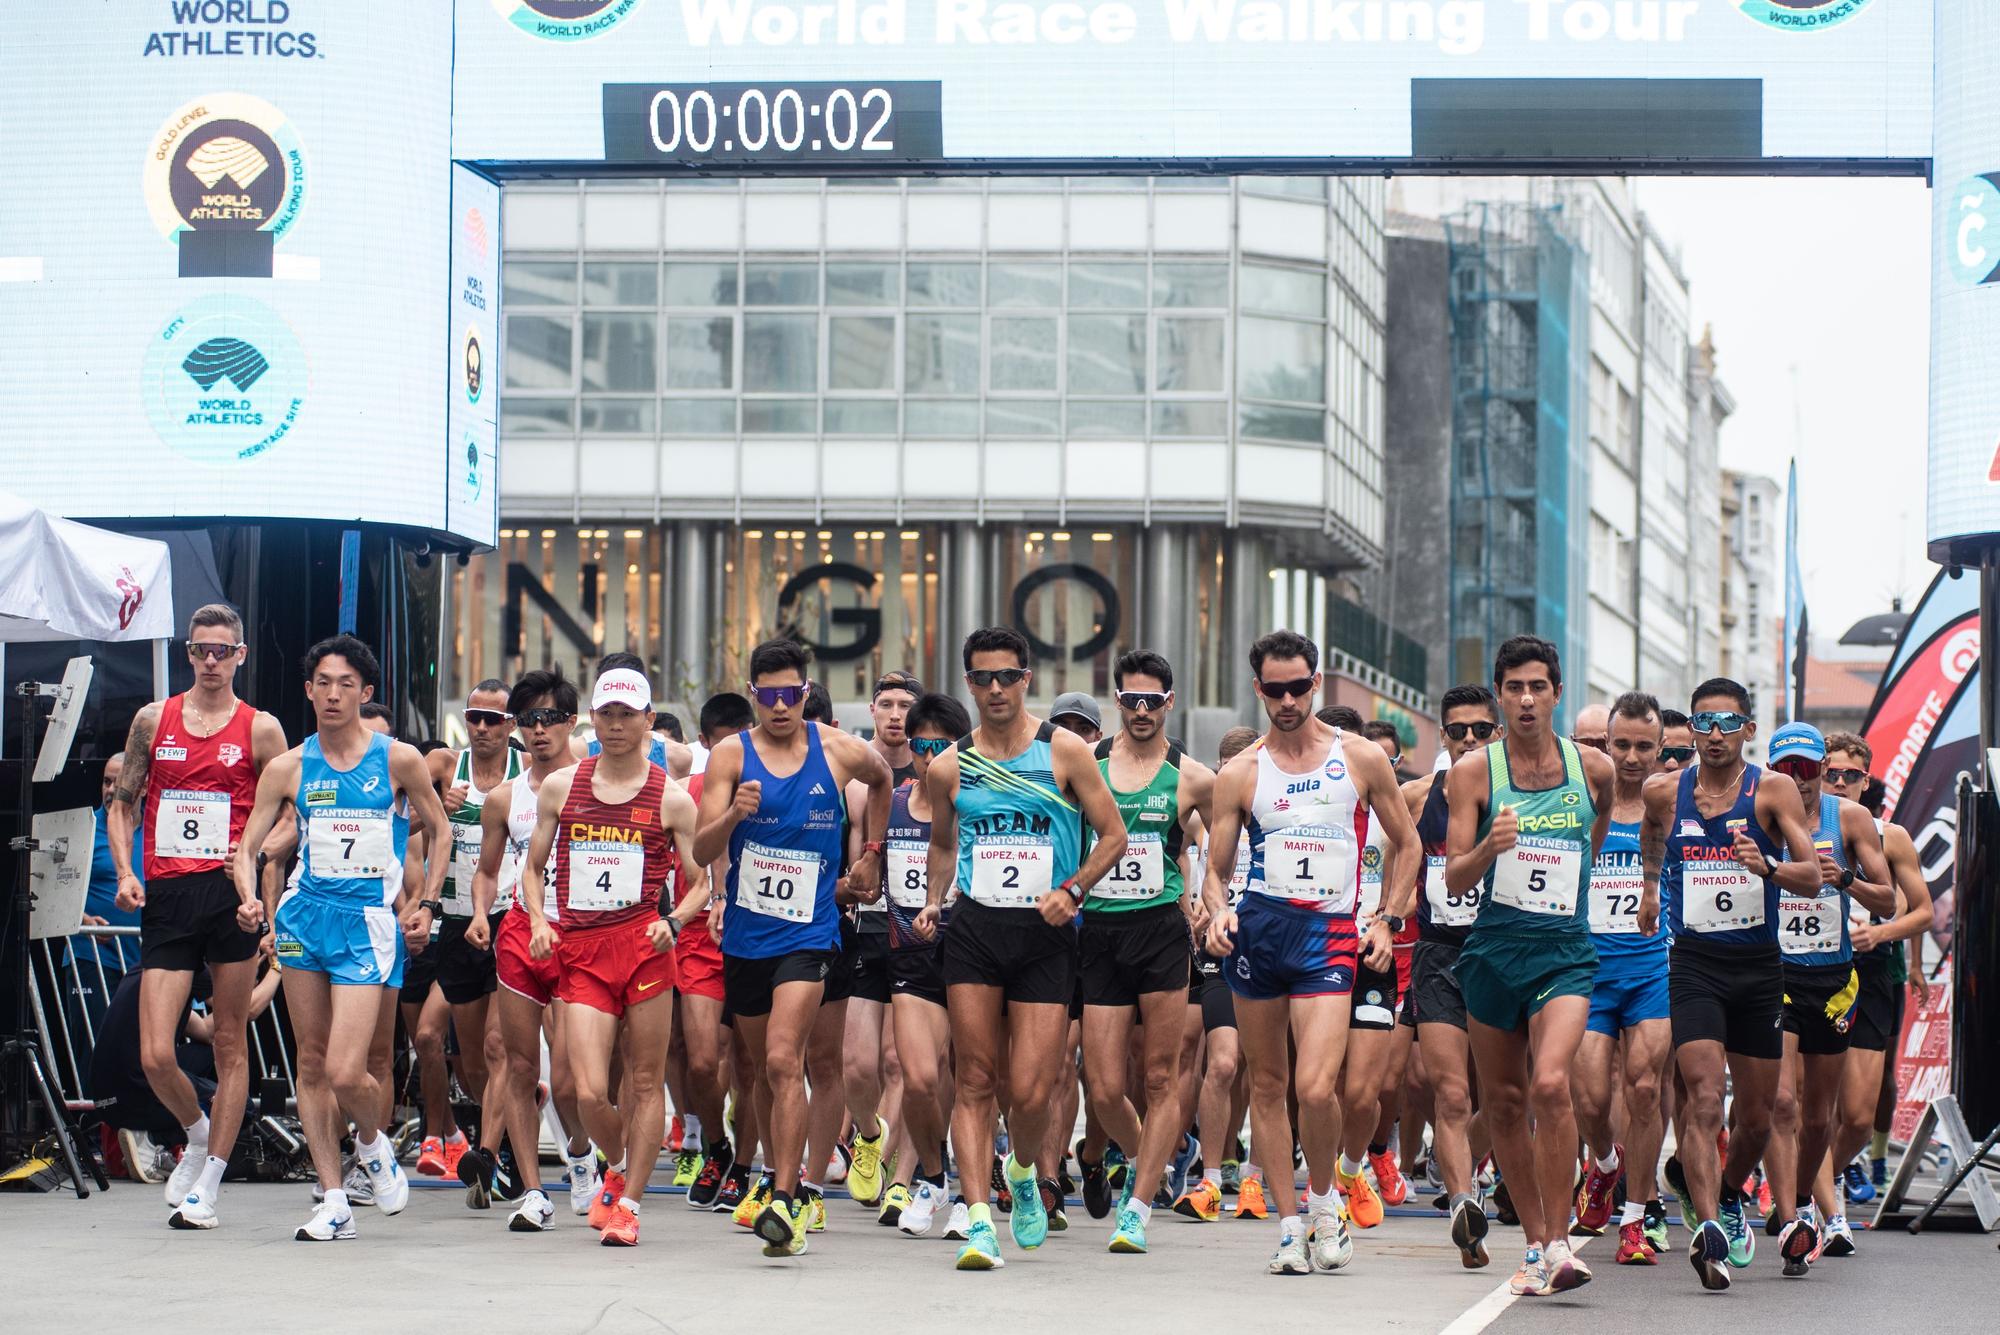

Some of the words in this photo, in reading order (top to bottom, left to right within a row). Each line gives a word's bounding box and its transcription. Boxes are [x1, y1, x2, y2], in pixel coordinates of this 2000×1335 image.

[172, 0, 290, 24] WORLD
[679, 0, 904, 46] World
[935, 0, 1137, 44] Race
[1163, 0, 1485, 55] Walking
[1515, 0, 1699, 43] Tour
[143, 31, 317, 58] ATHLETICS
[649, 88, 894, 153] 00:00:02
[201, 195, 251, 207] WORLD
[190, 208, 262, 219] ATHLETICS
[163, 316, 184, 340] CITY
[198, 400, 251, 411] WORLD
[186, 413, 263, 425] ATHLETICS
[603, 682, 637, 692] CHINA
[1775, 737, 1814, 748] COLOMBIA
[167, 749, 186, 757] EWP
[1286, 779, 1321, 794] aula
[163, 790, 229, 802] CANTONES23
[176, 805, 205, 814] LINKE
[183, 819, 199, 840] 8
[333, 824, 360, 833] KOGA
[973, 813, 1052, 836] UCAM
[570, 823, 644, 846] CHINA
[978, 836, 1051, 846] CANTONES23
[340, 838, 356, 860] 7
[748, 841, 819, 860] CANTONES23
[1284, 840, 1325, 852] MARTÍN
[587, 856, 620, 866] ZHANG
[981, 850, 1015, 861] LOPEZ,
[1018, 852, 1041, 861] M.A.
[1517, 851, 1561, 865] BONFIM
[753, 859, 803, 875] HURTADO
[1109, 860, 1142, 882] 13
[1295, 857, 1314, 880] 1
[595, 871, 612, 893] 4
[1002, 865, 1020, 888] 2
[1527, 869, 1548, 893] 5
[1693, 876, 1737, 886] PINTADO
[1740, 875, 1750, 884] B.
[757, 875, 794, 901] 10
[1606, 894, 1639, 915] 72
[1715, 890, 1734, 912] 6
[1778, 903, 1813, 912] PEREZ,
[1816, 902, 1826, 911] K.
[1785, 915, 1821, 936] 48
